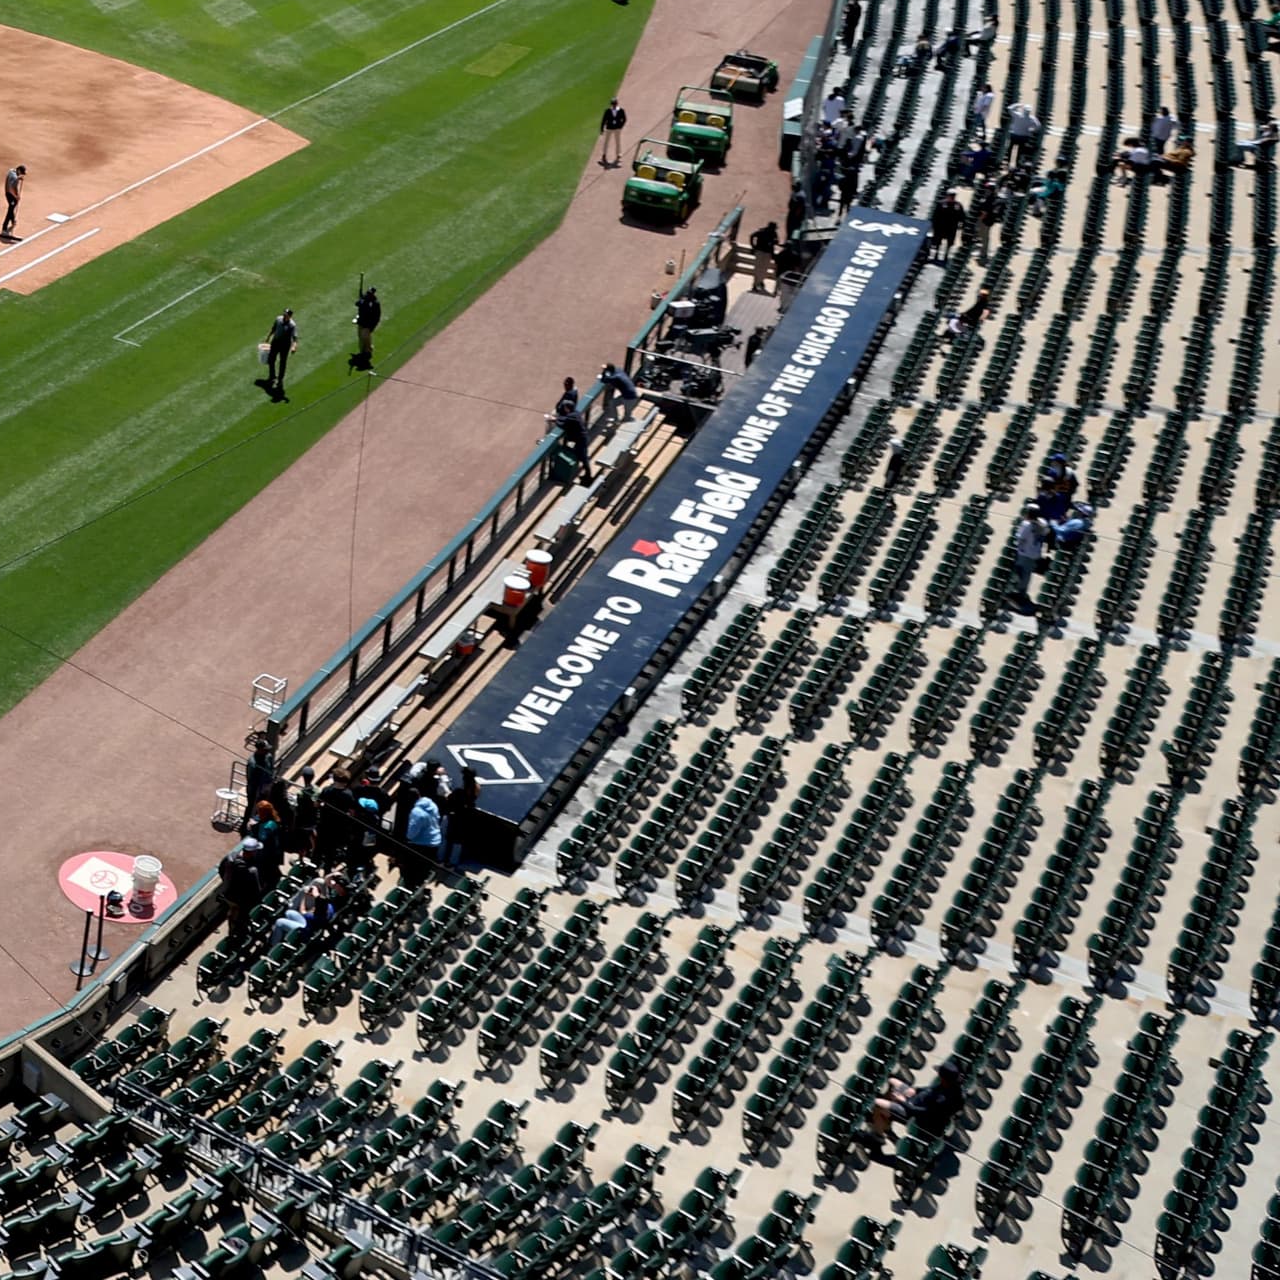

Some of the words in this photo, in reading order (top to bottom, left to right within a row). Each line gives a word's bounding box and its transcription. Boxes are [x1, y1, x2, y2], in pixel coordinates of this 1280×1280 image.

[850, 241, 889, 269] SOX
[825, 266, 874, 307] WHITE
[791, 306, 851, 367] CHICAGO
[769, 364, 816, 395] THE
[755, 393, 793, 418] OF
[721, 415, 781, 465] HOME
[607, 529, 719, 598] Rate
[670, 465, 762, 535] Field
[500, 623, 621, 735] WELCOME
[593, 596, 643, 626] TO
